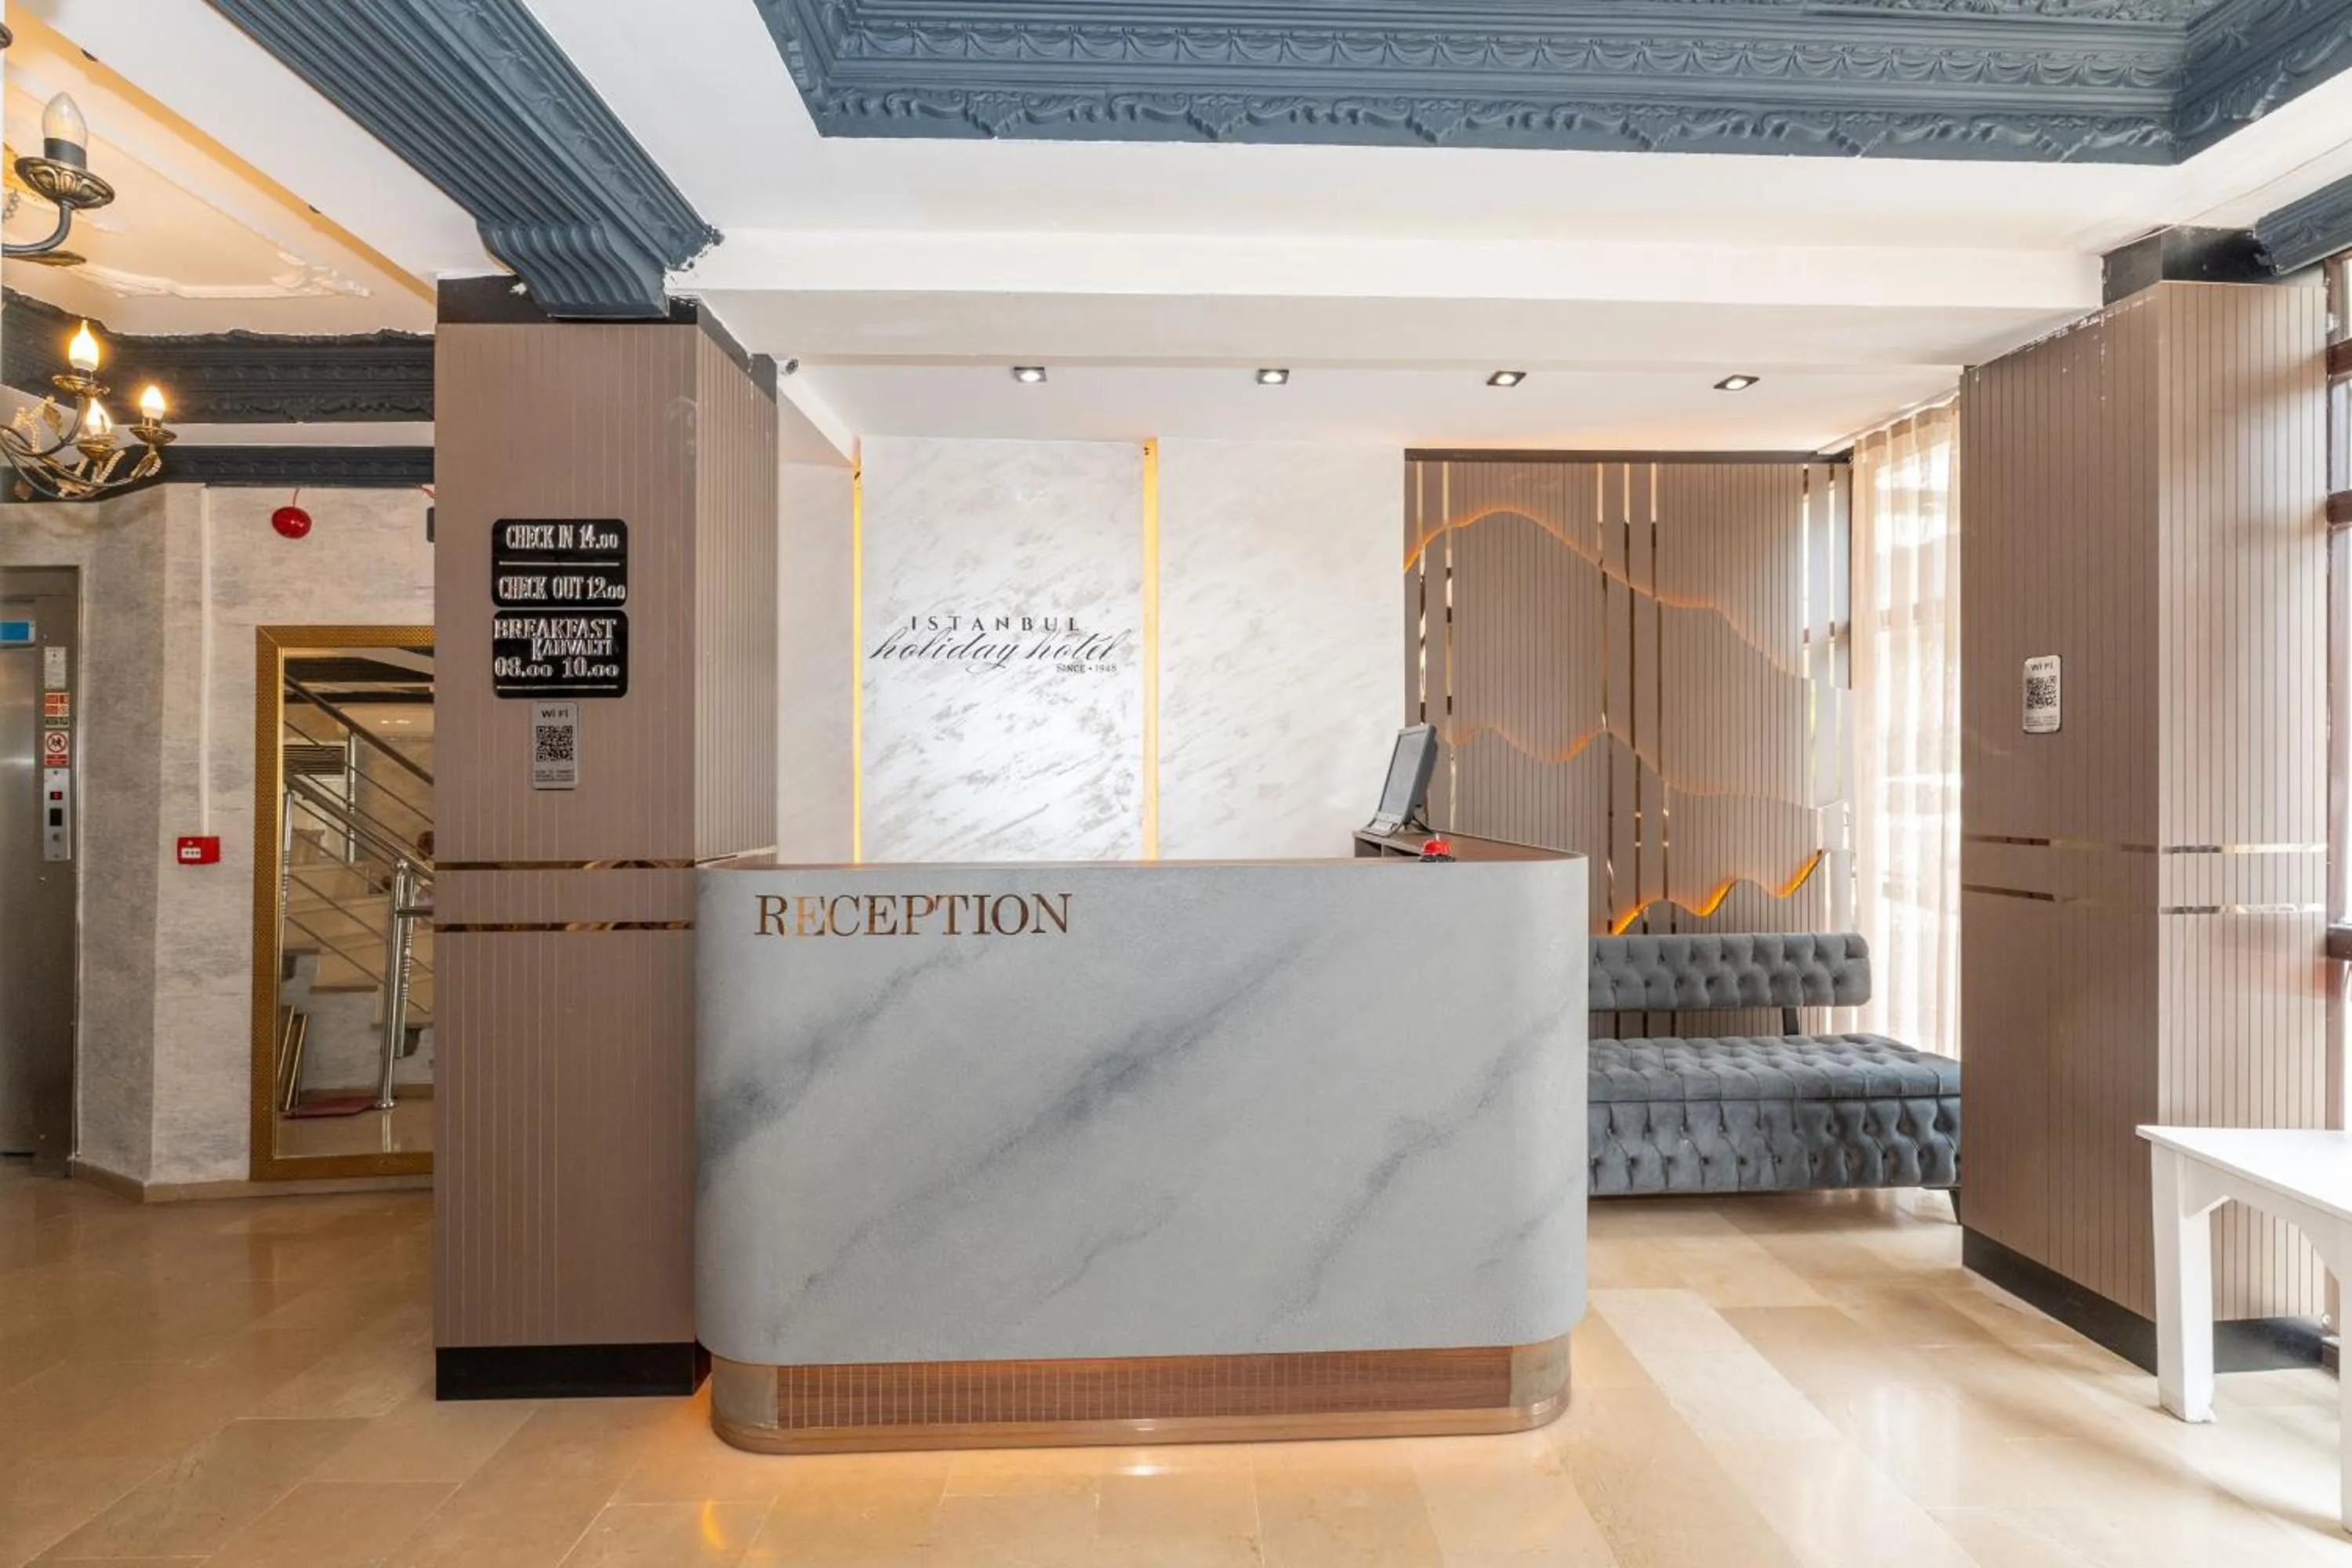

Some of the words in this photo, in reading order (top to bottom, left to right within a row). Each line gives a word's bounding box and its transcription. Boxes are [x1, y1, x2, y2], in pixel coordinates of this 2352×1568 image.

[506, 524, 554, 549] CHECK
[558, 524, 574, 549] IN
[579, 524, 619, 549] 14.00
[499, 576, 548, 600] CHECK
[553, 576, 584, 600] OUT
[494, 619, 617, 639] BREAKFAST
[912, 615, 1080, 632] ISTANBUL
[869, 626, 1020, 674] holiday
[494, 656, 554, 677] 08.00
[561, 656, 620, 678] 10.00
[754, 894, 1072, 935] RECEPTION
